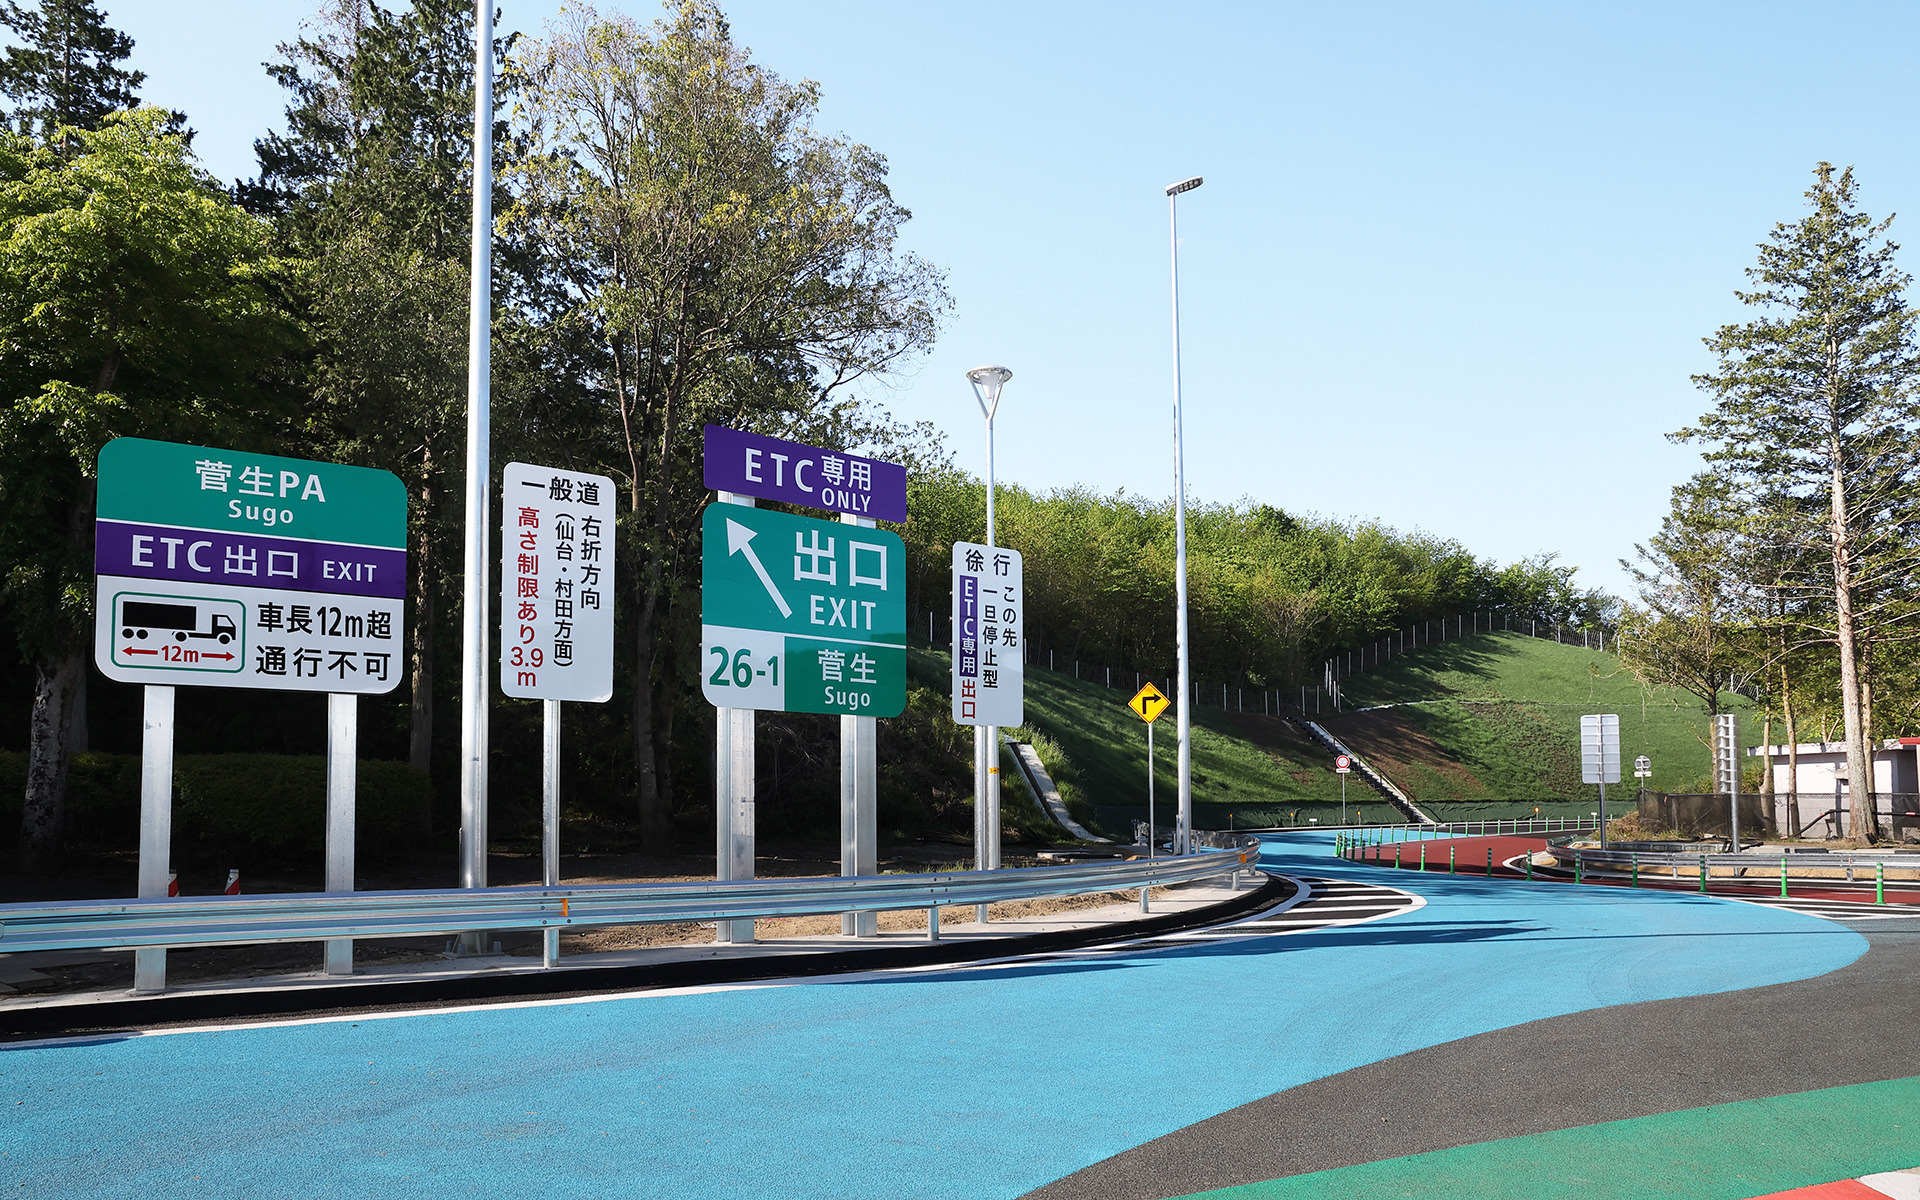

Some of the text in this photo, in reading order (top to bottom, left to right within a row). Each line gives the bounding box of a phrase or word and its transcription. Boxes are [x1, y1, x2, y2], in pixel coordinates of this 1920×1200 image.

[195, 459, 326, 502] 菅生PA
[521, 476, 600, 506] 一般道
[228, 499, 294, 527] Sugo
[821, 487, 871, 513] ONLY
[322, 560, 377, 582] EXIT
[580, 515, 602, 610] 右折方向
[793, 530, 887, 591] 出口
[965, 549, 1011, 577] 徐行
[256, 602, 392, 640] 車長12m超
[810, 594, 877, 630] EXIT
[1002, 586, 1017, 647] この先
[161, 645, 199, 663] 12m
[982, 587, 998, 689] 一旦停止型
[255, 644, 391, 682] 通行不可
[709, 646, 779, 688] 26-1
[817, 649, 877, 685] 菅生
[824, 686, 871, 711] Sugo
